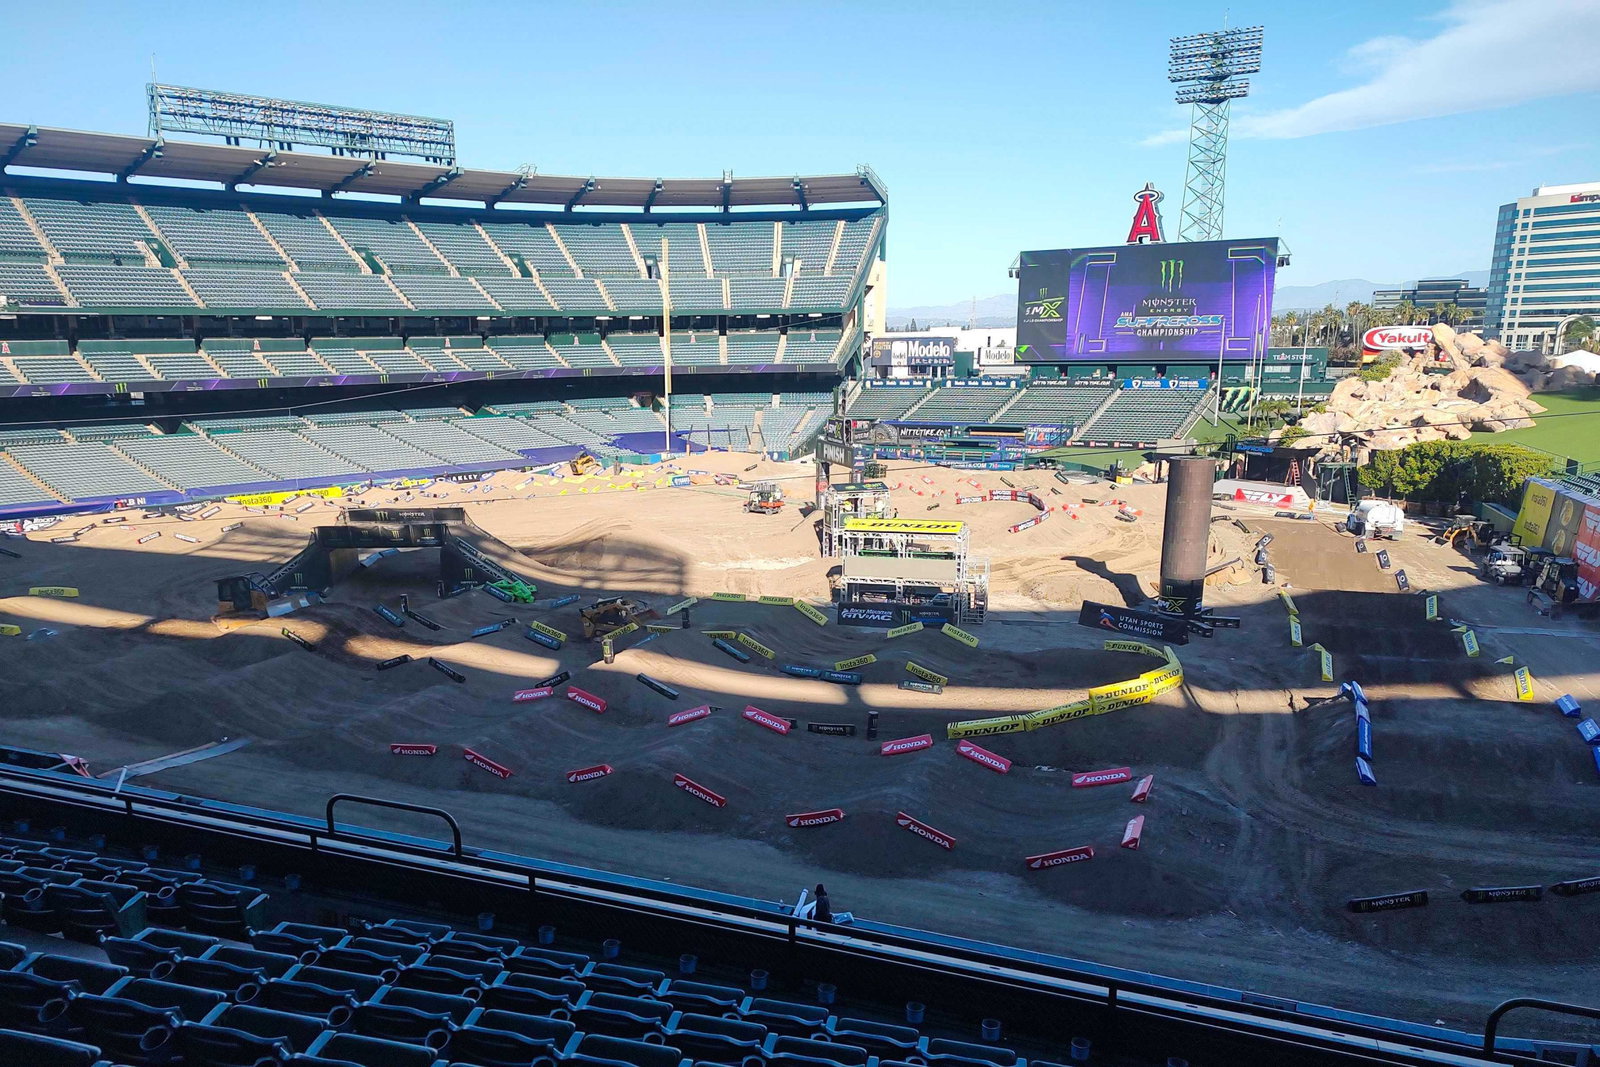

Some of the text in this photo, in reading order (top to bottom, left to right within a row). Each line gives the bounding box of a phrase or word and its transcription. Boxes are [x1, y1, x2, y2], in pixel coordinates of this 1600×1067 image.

[1142, 297, 1197, 307] MONSTER
[1114, 314, 1224, 328] SUPERCROSS
[1136, 328, 1199, 337] CHAMPIONSHIP
[1378, 330, 1431, 344] Yakult
[908, 340, 951, 358] Modelo
[985, 349, 1011, 361] Modelo
[1272, 353, 1313, 361] TEAM STORE
[823, 442, 845, 464] FINISH
[799, 603, 823, 622] Insta360
[891, 624, 917, 636] Insta360
[1118, 622, 1163, 637] COMMISSION
[1119, 615, 1164, 630] UTAH SPORTS
[536, 623, 562, 639] Insta360
[947, 626, 975, 643] Insta360
[742, 637, 769, 657] Insta360
[1111, 643, 1143, 651] DUNLOP
[840, 657, 869, 671] Insta360
[911, 665, 942, 683] Insta360
[1154, 669, 1181, 685] DUNLOP
[1517, 669, 1529, 695] SUZUKI
[522, 690, 549, 699] HONDA
[1105, 683, 1149, 699] DUNLOP
[575, 695, 601, 711] HONDA
[1108, 695, 1148, 711] DUNLOP
[677, 708, 705, 721] HONDA
[1042, 707, 1090, 726] DUNLOP
[754, 714, 785, 731] HONDA
[963, 722, 1020, 738] DUNLOP
[893, 739, 928, 751] HONDA
[970, 750, 1006, 770] HONDA
[473, 759, 503, 777] HONDA
[577, 771, 605, 781] HONDA
[1086, 772, 1127, 782] HONDA
[685, 784, 720, 807] HONDA
[800, 815, 838, 827] HONDA
[909, 824, 950, 848] HONDA
[1043, 852, 1089, 867] HONDA
[1488, 889, 1526, 897] MONSTER
[1371, 896, 1411, 907] MONSTER
